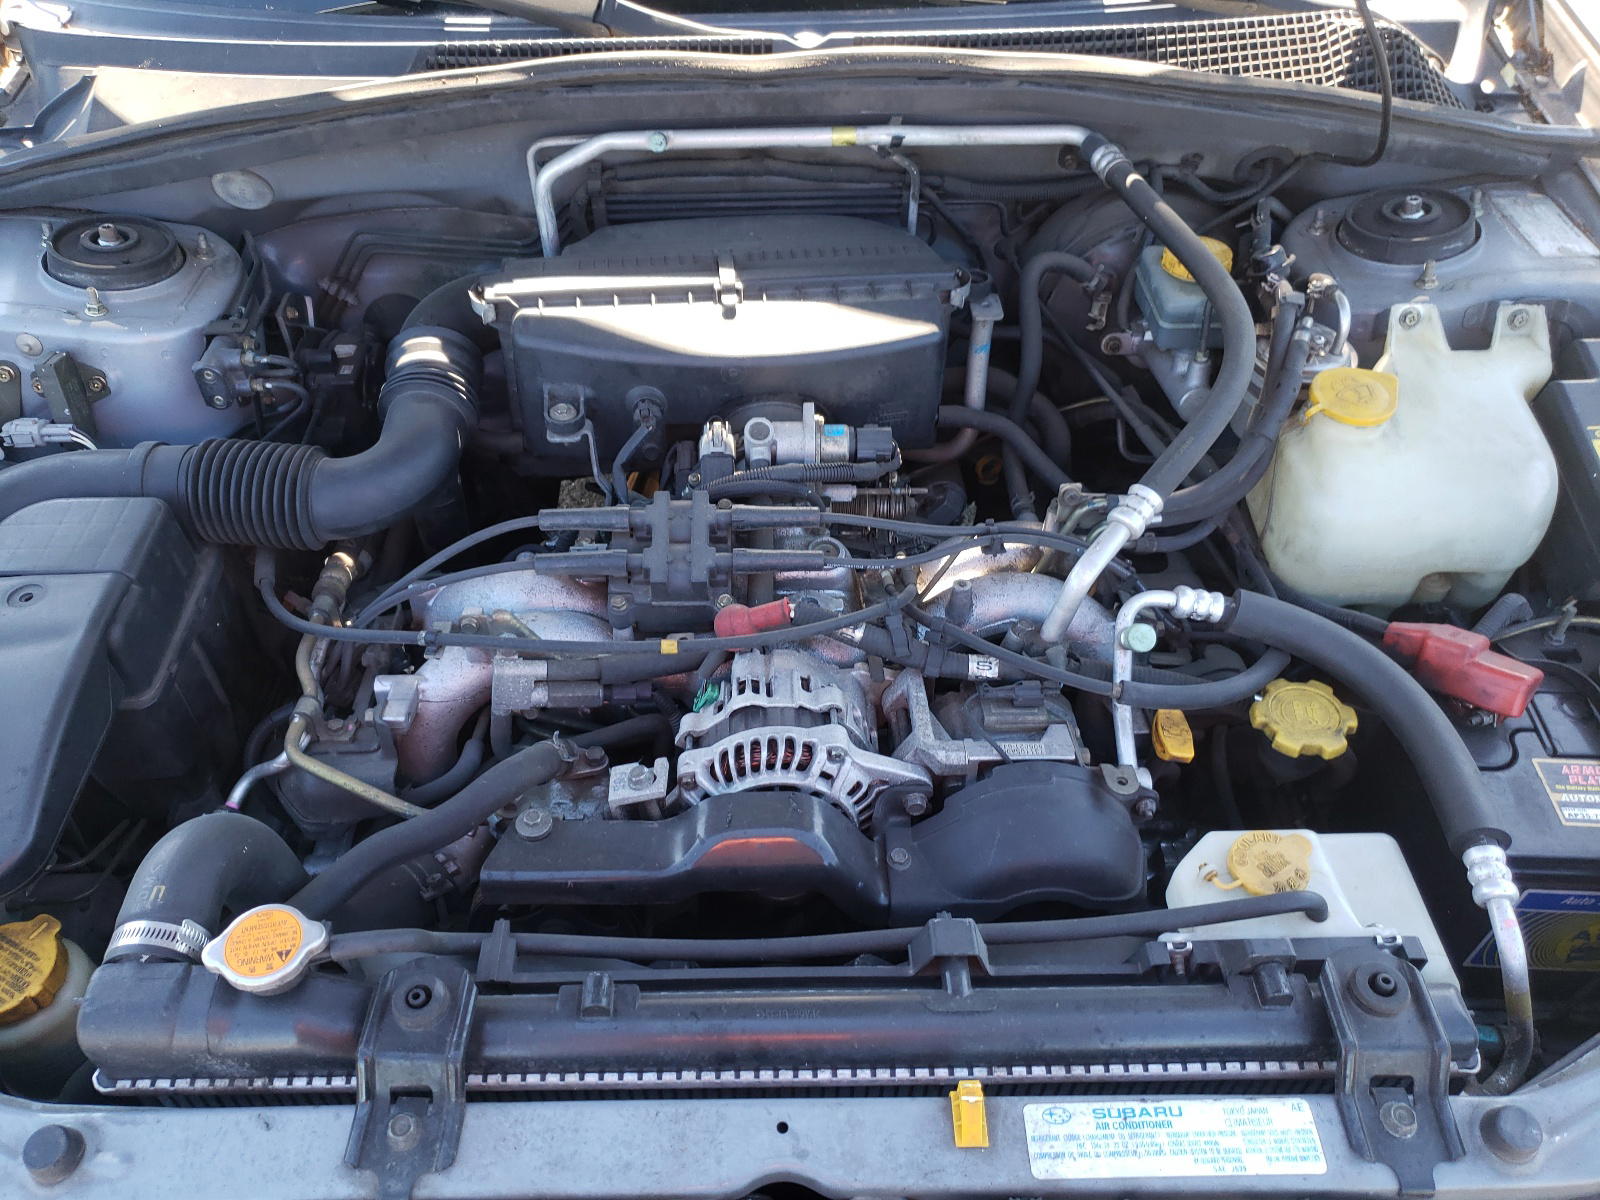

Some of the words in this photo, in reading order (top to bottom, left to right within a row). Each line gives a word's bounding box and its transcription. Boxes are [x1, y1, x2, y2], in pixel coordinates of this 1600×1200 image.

[1560, 896, 1596, 906] Auto
[237, 952, 275, 967] WARNING
[1091, 1105, 1183, 1119] SUBARU
[1095, 1121, 1111, 1131] AIR
[1112, 1120, 1173, 1130] CONDITIONER
